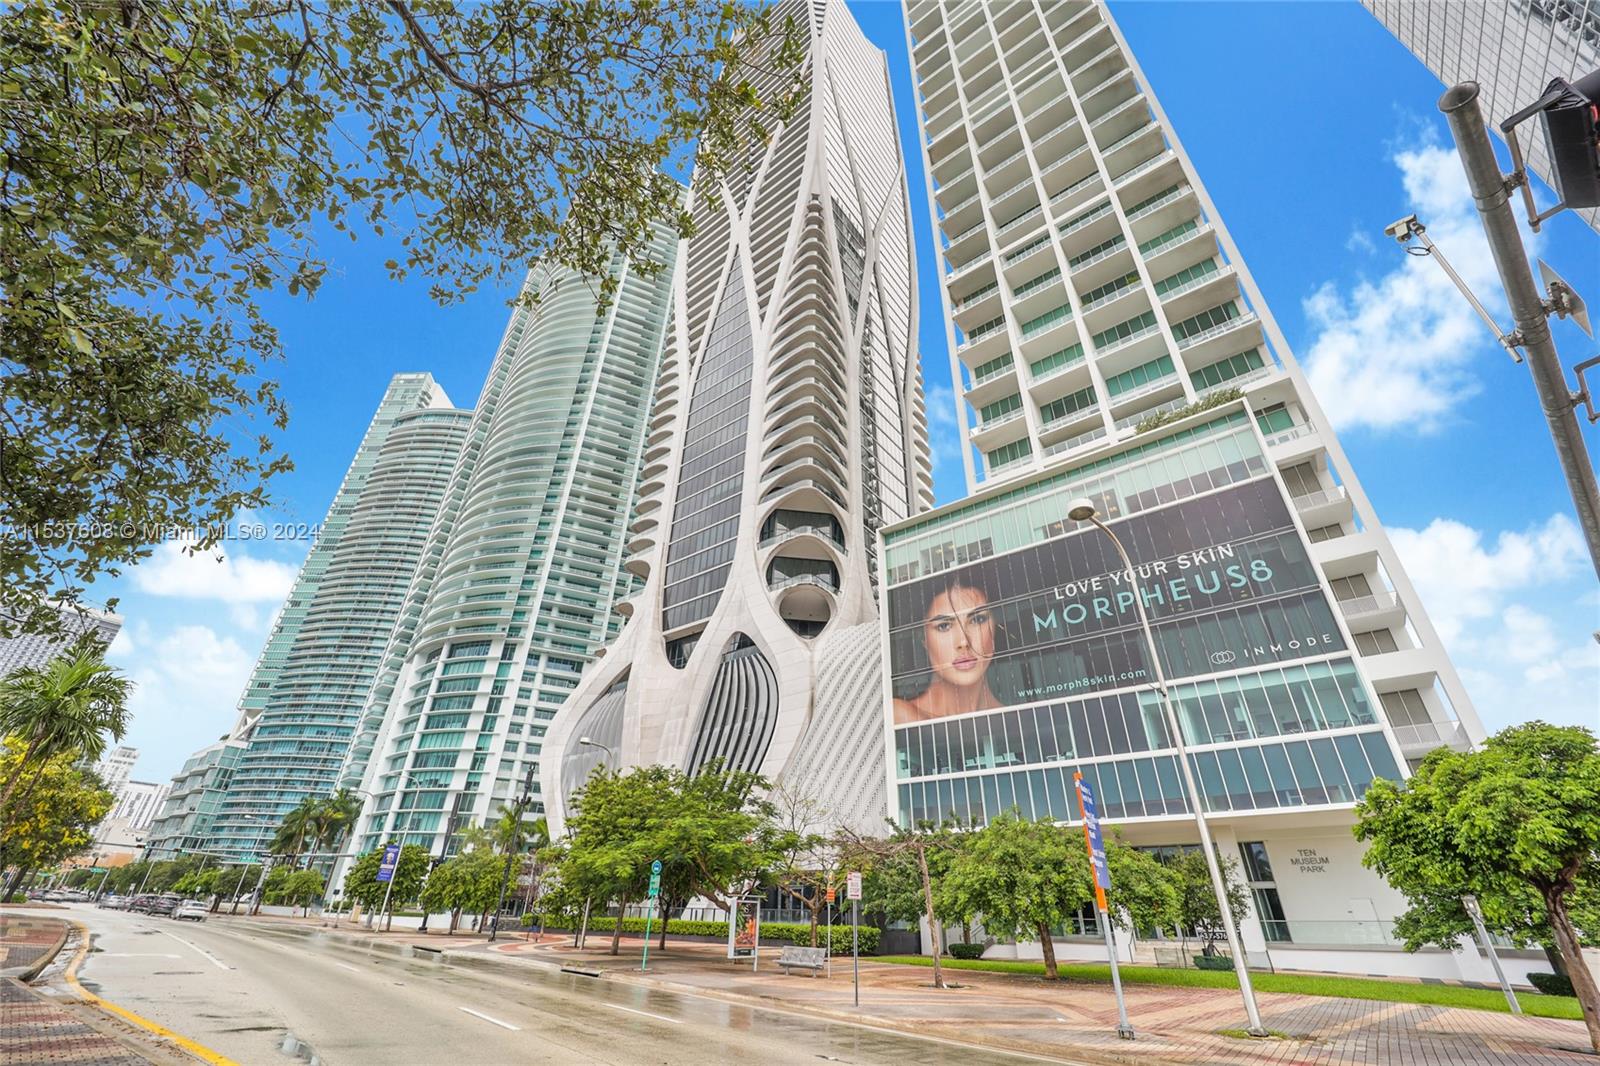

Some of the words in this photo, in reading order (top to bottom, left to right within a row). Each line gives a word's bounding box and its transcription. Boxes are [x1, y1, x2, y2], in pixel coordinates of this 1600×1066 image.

[1054, 577, 1102, 600] LOVE
[1109, 561, 1168, 586] YOUR
[1177, 544, 1234, 570] SKIN
[1033, 559, 1273, 633] MORPHEUS8
[1017, 668, 1147, 697] www.morph8skin.com
[1290, 857, 1330, 865] MUSEUM
